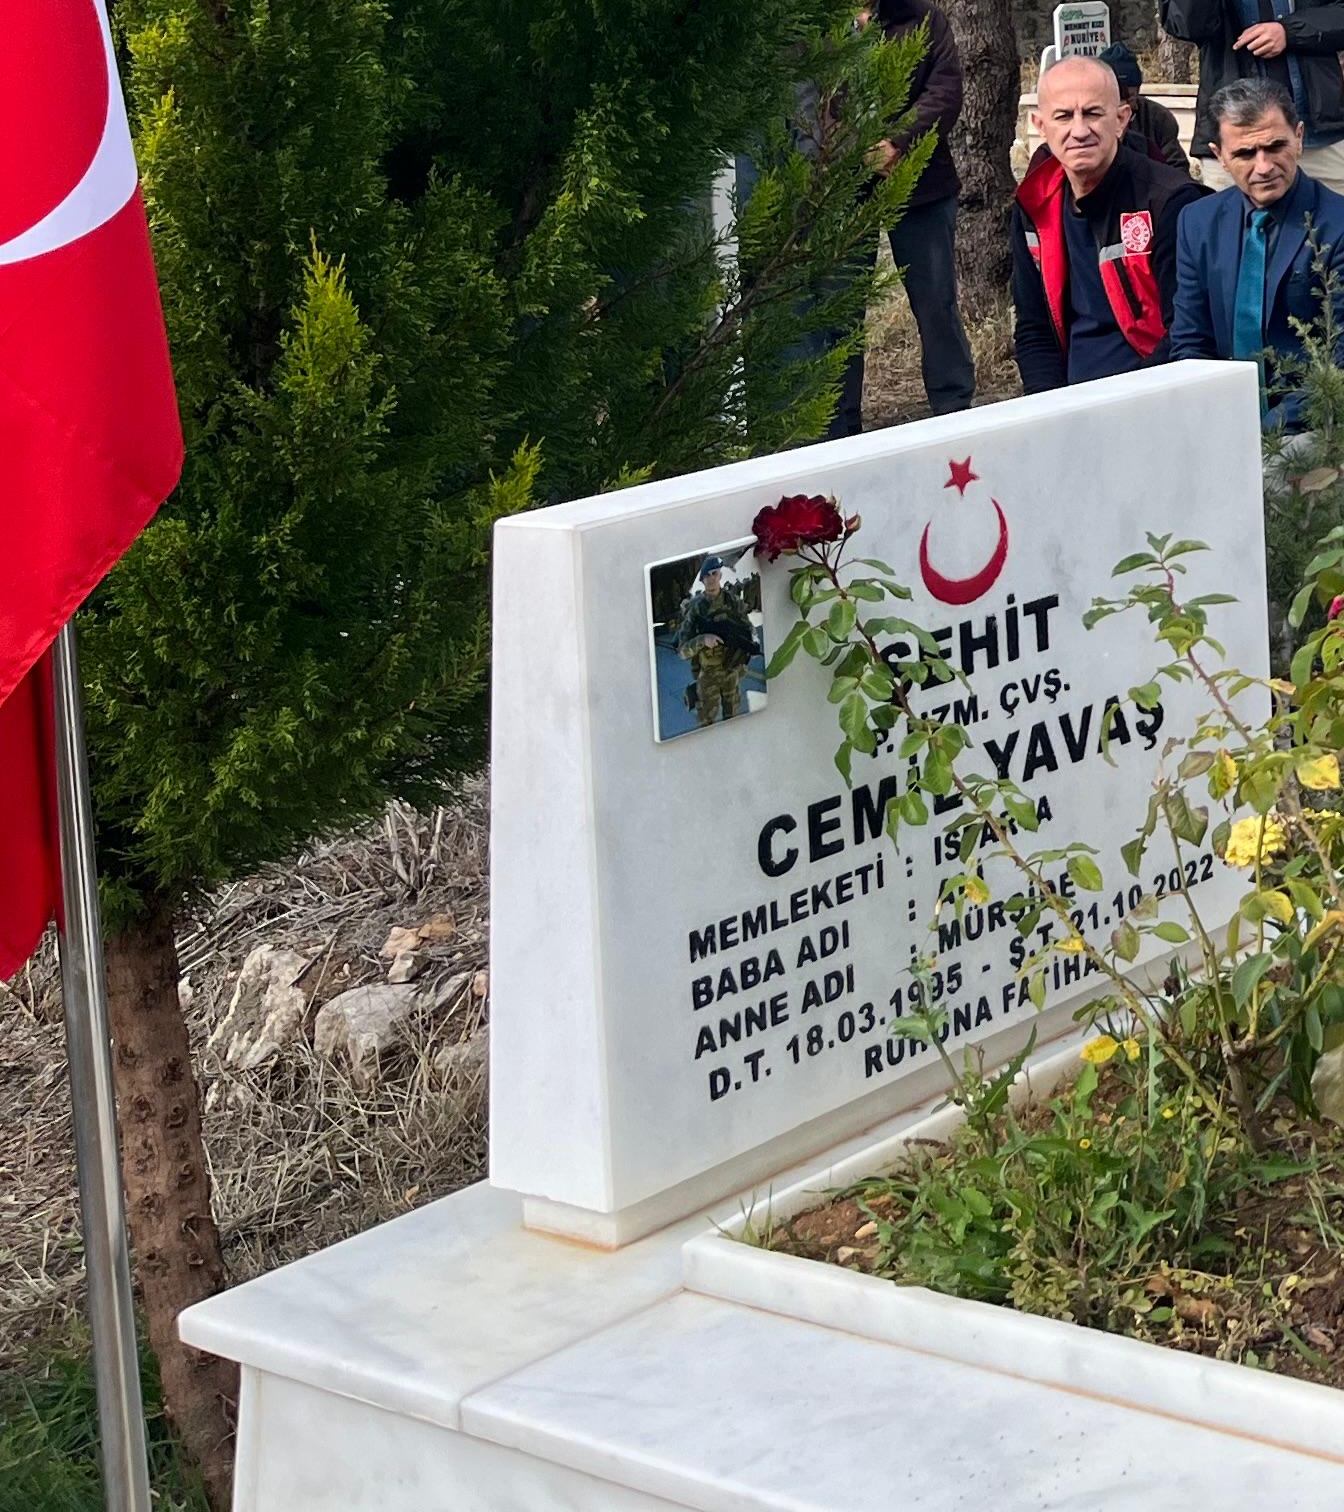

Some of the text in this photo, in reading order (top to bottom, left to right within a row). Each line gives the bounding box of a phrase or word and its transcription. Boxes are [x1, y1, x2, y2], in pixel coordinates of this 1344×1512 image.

[1000, 668, 1070, 720] ÇVŞ.
[983, 695, 1165, 784] YAVAŞ
[688, 852, 885, 964] MEMLEKETİ
[692, 948, 786, 1011] BABA
[796, 919, 850, 968] ADI
[695, 991, 790, 1060] ANNE
[801, 963, 856, 1014] ADI
[709, 1049, 772, 1102] D.T.
